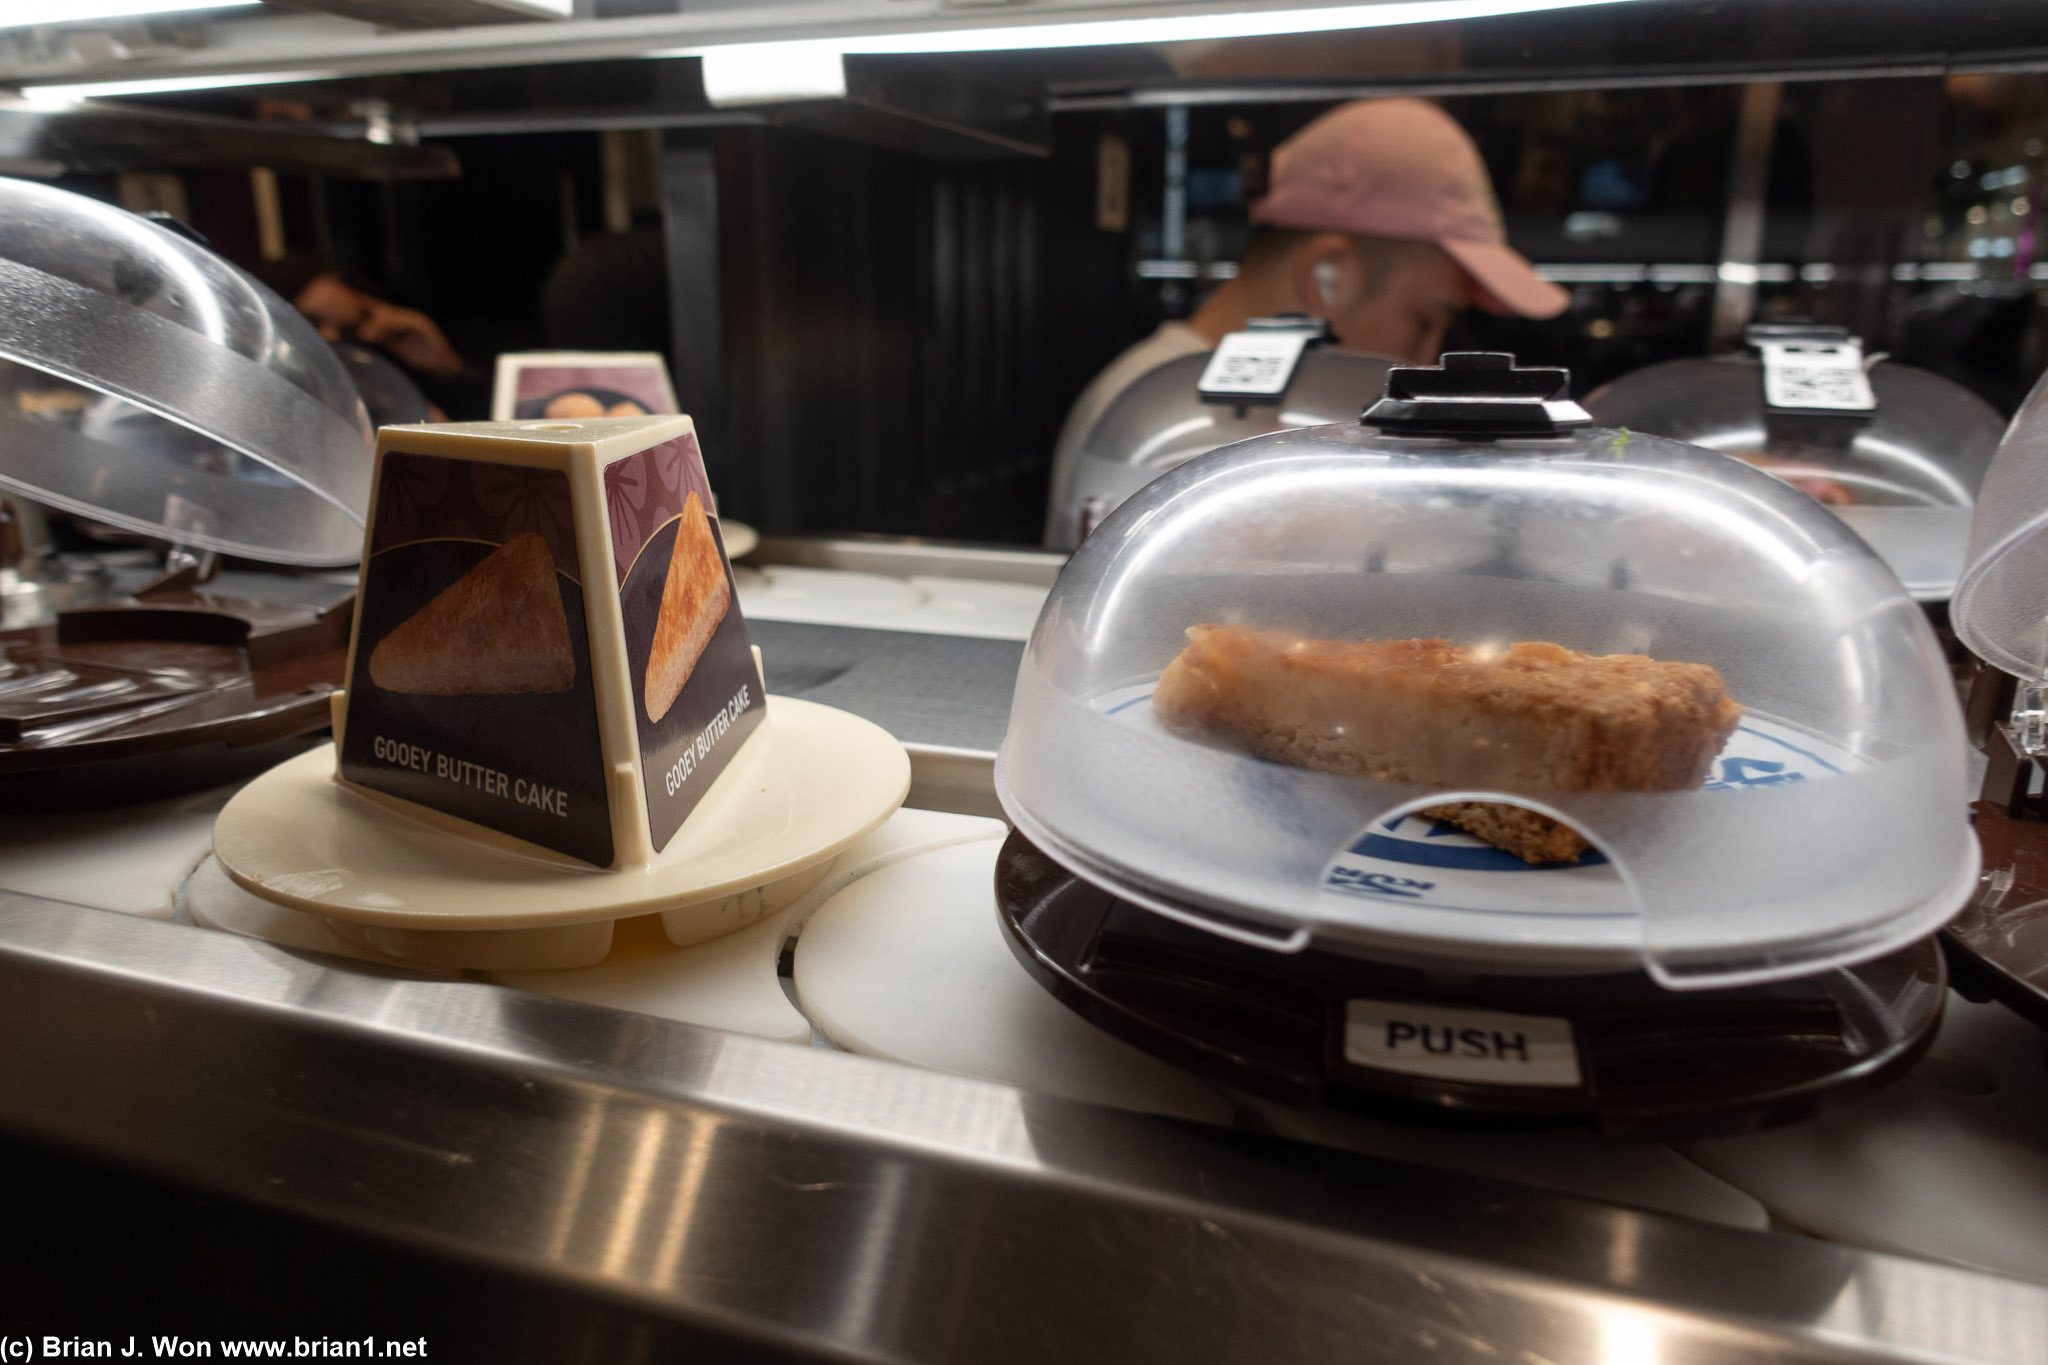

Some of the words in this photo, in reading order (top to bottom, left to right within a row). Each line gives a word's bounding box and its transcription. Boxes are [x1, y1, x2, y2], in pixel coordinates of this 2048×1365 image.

[374, 735, 432, 773] GOOEY
[437, 753, 509, 799] BUTTER
[514, 778, 568, 818] CAKE
[665, 743, 697, 797] GOOEY
[696, 708, 730, 760] BUTTER
[728, 684, 750, 722] CAKE
[1385, 1019, 1529, 1062] PUSH
